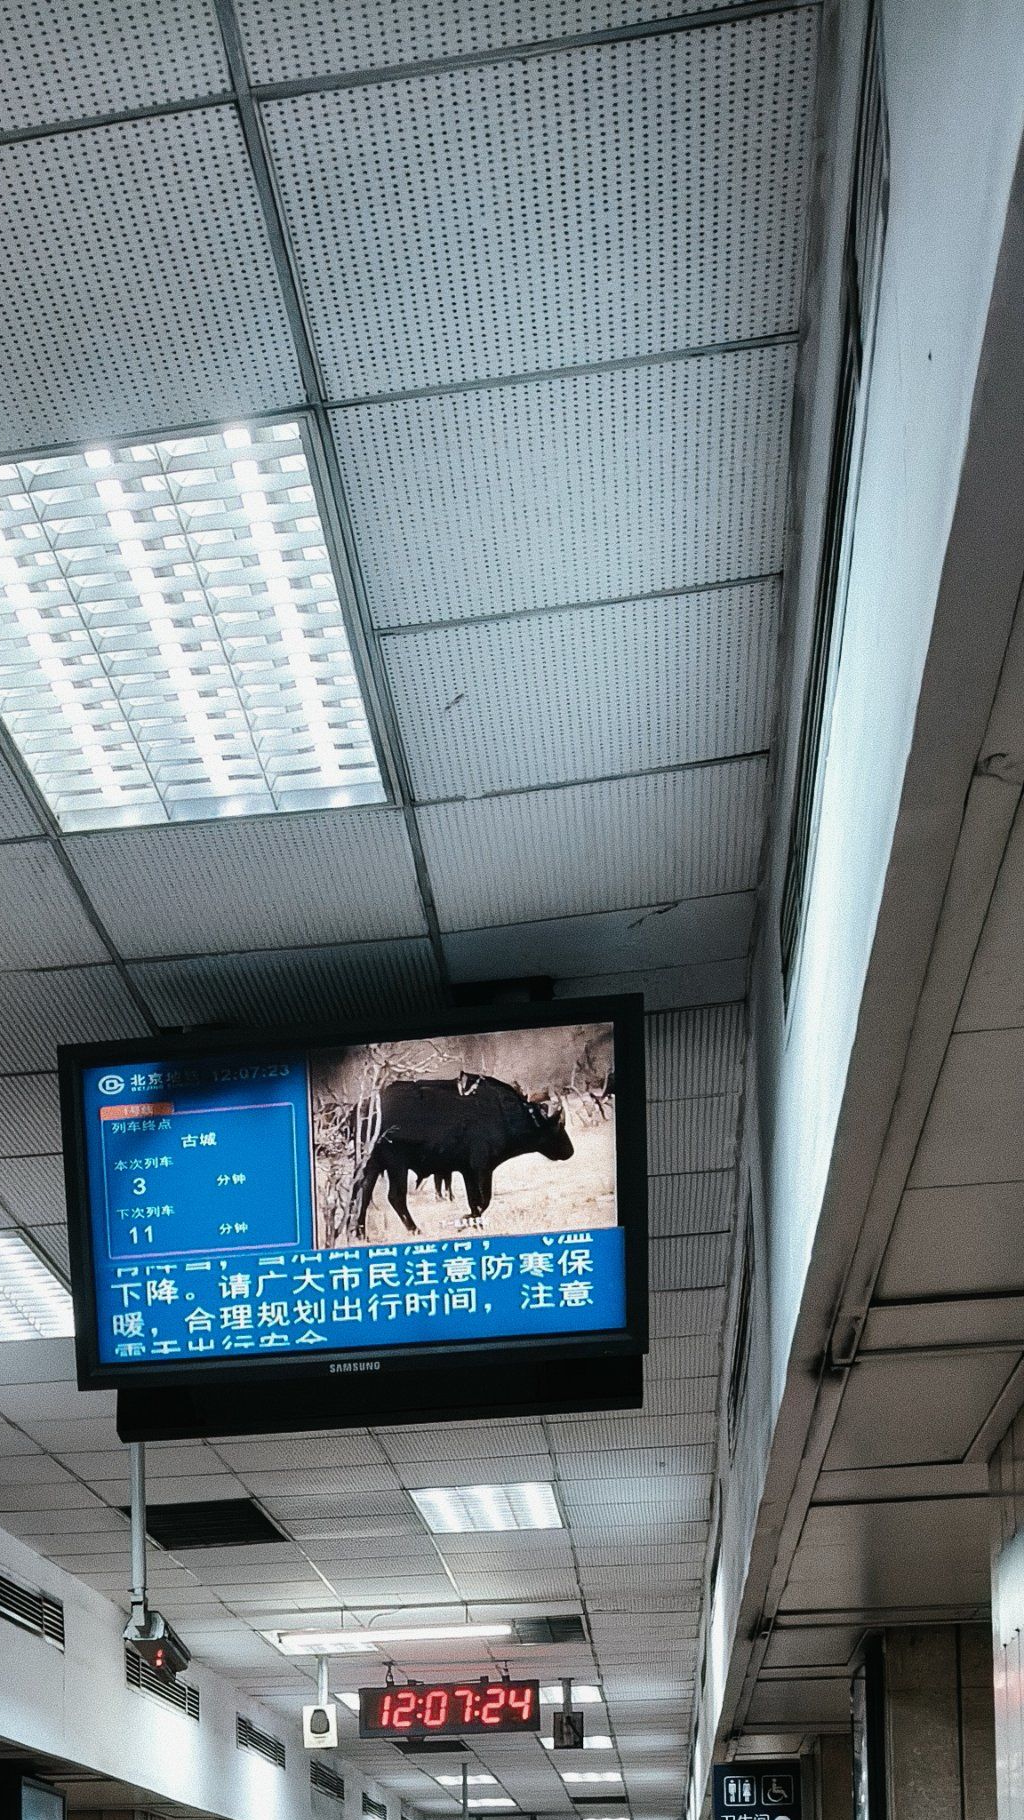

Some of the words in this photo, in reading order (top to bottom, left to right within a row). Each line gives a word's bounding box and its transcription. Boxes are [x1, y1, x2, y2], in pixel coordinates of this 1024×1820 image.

[130, 1070, 200, 1087] 北京地
[111, 1119, 172, 1134] 列车终点
[181, 1132, 217, 1148] 古城
[114, 1156, 174, 1171] 本次列车
[133, 1177, 147, 1196] 3
[217, 1173, 246, 1186] 分钟
[116, 1205, 175, 1220] 下次列车
[129, 1225, 153, 1244] 11
[219, 1222, 248, 1235] 分钟
[329, 1361, 381, 1373] SAMSUNG
[381, 1688, 532, 1727] 12:07:24
